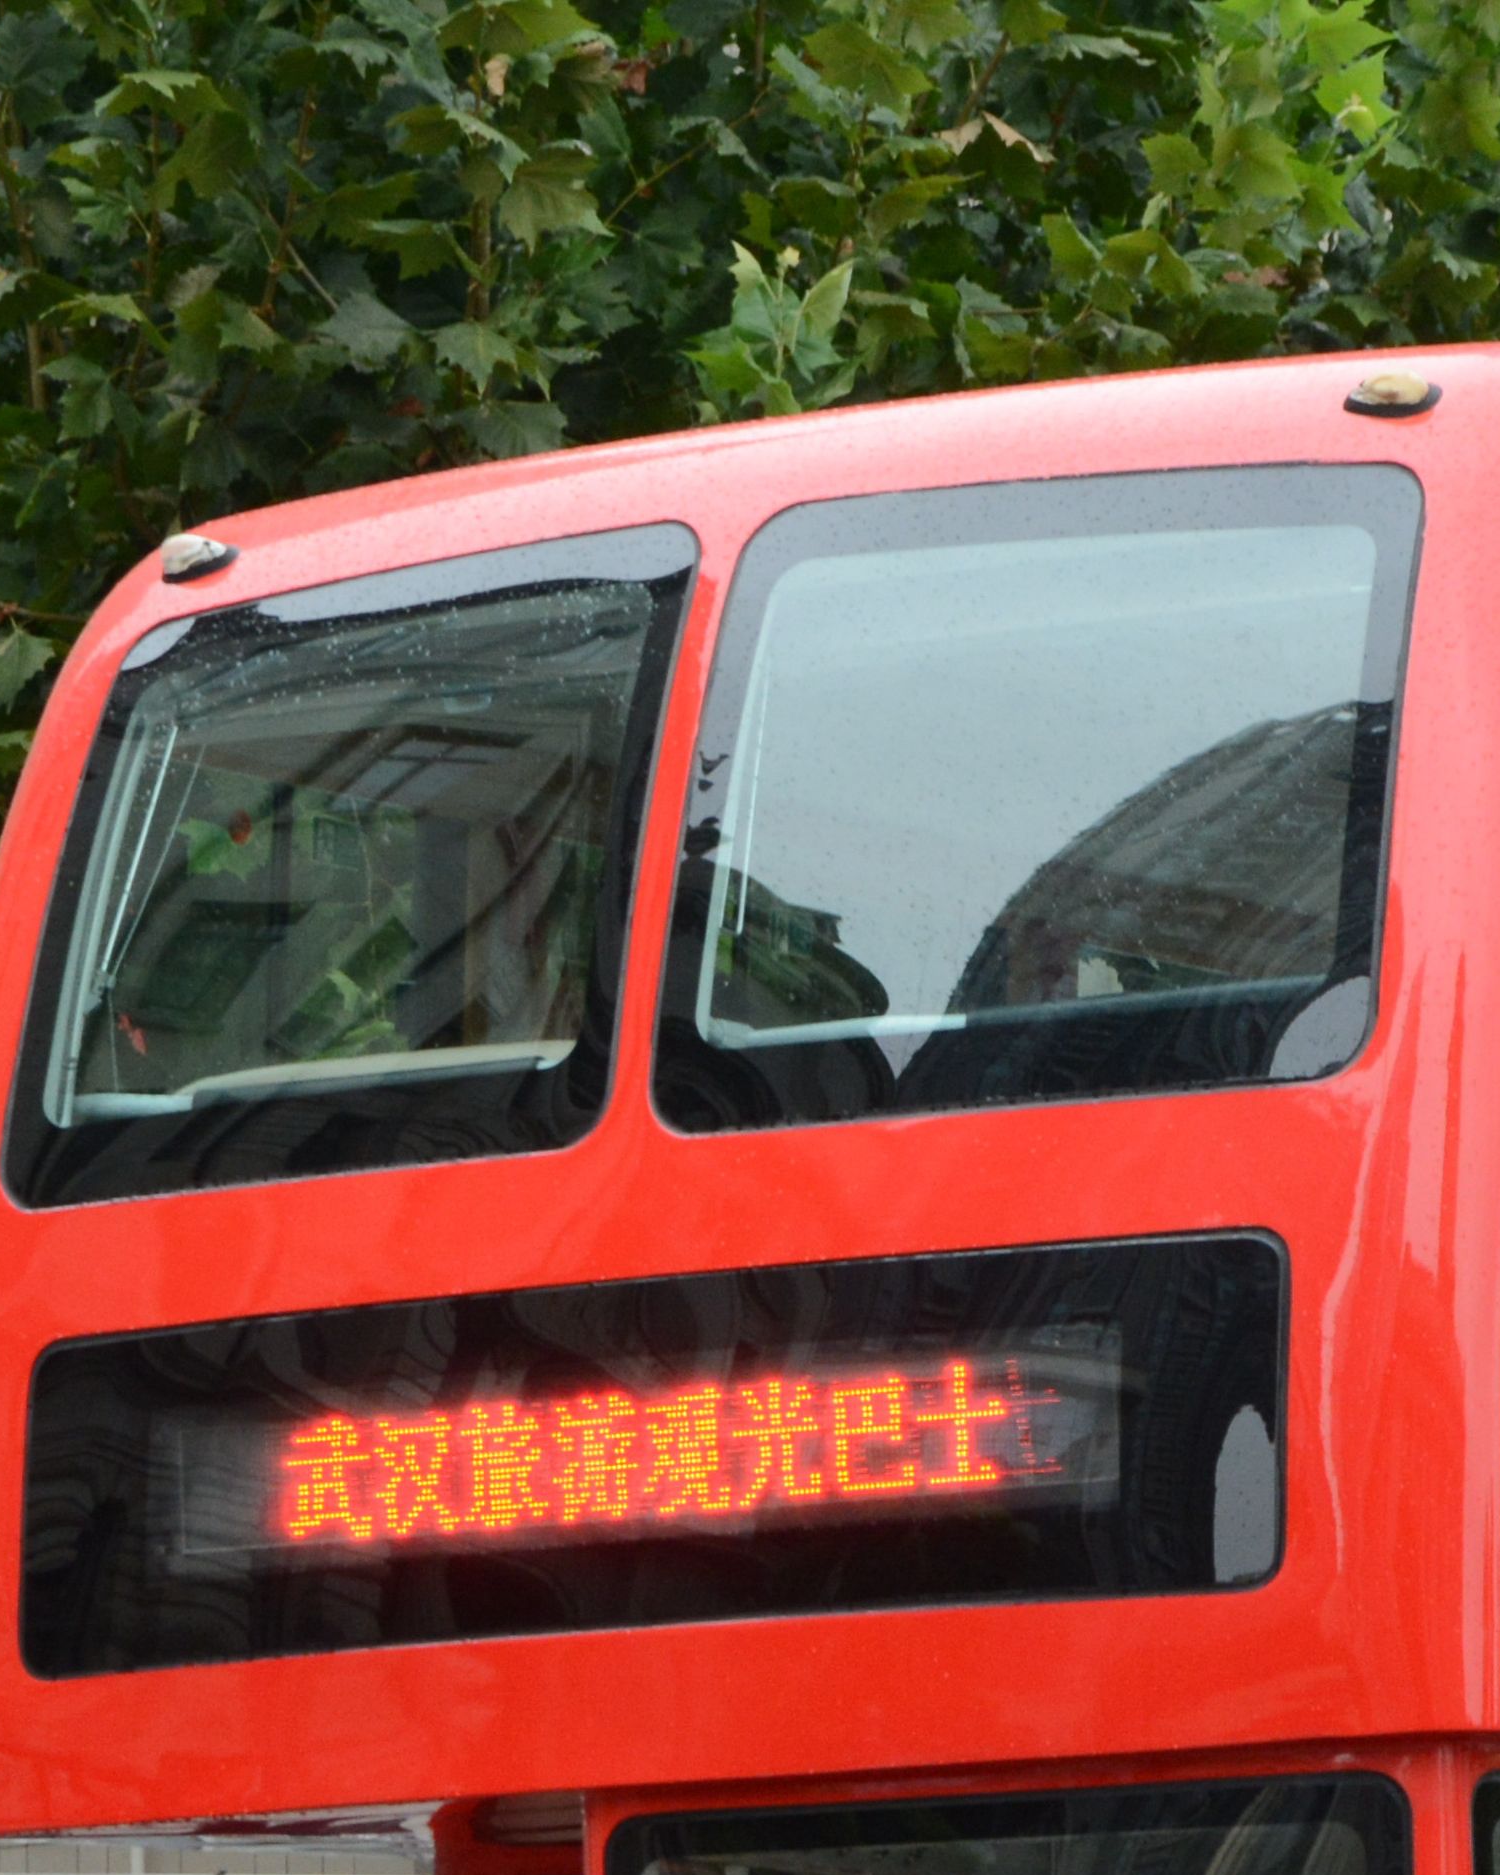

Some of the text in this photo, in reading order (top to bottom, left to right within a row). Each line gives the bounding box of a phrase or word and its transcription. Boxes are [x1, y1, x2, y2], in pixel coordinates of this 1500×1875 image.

[285, 1361, 1007, 1537] 武汉旅游观光巴士
